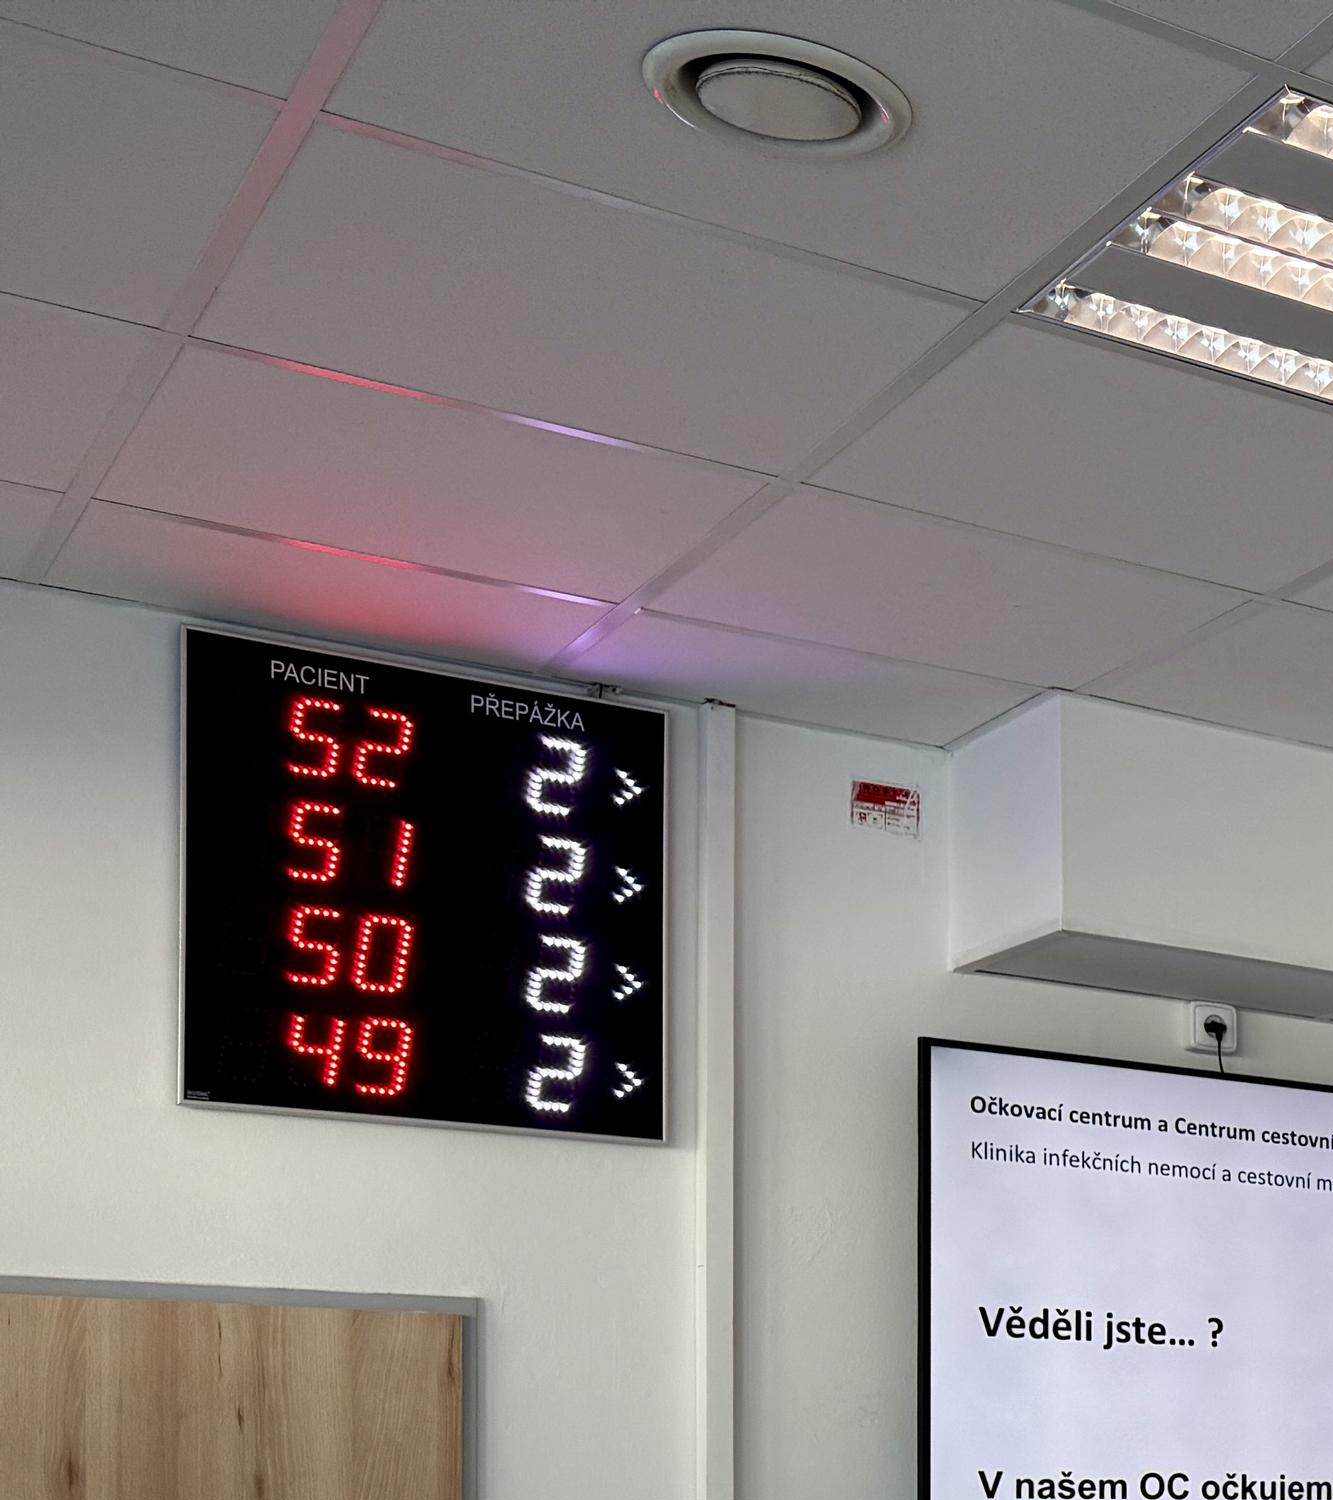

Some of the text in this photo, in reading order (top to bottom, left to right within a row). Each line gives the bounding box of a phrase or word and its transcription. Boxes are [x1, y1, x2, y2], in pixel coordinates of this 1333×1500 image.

[272, 660, 369, 693] PACIENT
[471, 693, 586, 731] PŘEPÁŽKA
[288, 696, 587, 816] 52 2
[287, 801, 586, 915] 51 2
[287, 905, 586, 1013] 50 2
[287, 1014, 586, 1112] 49 2
[971, 1096, 1063, 1121] Očkovací
[1070, 1111, 1151, 1130] centrum
[1158, 1120, 1167, 1132] a
[1175, 1118, 1255, 1141] Centrum
[972, 1142, 1035, 1163] Klinika
[1044, 1148, 1140, 1173] infekčních
[1149, 1163, 1216, 1180] nemocí
[1222, 1169, 1231, 1181] a
[1238, 1171, 1311, 1189] cestovní
[979, 1306, 1223, 1349] Věděli jste... ?
[978, 1471, 1003, 1498] V
[1016, 1472, 1127, 1499] našem
[1140, 1473, 1189, 1500] OC
